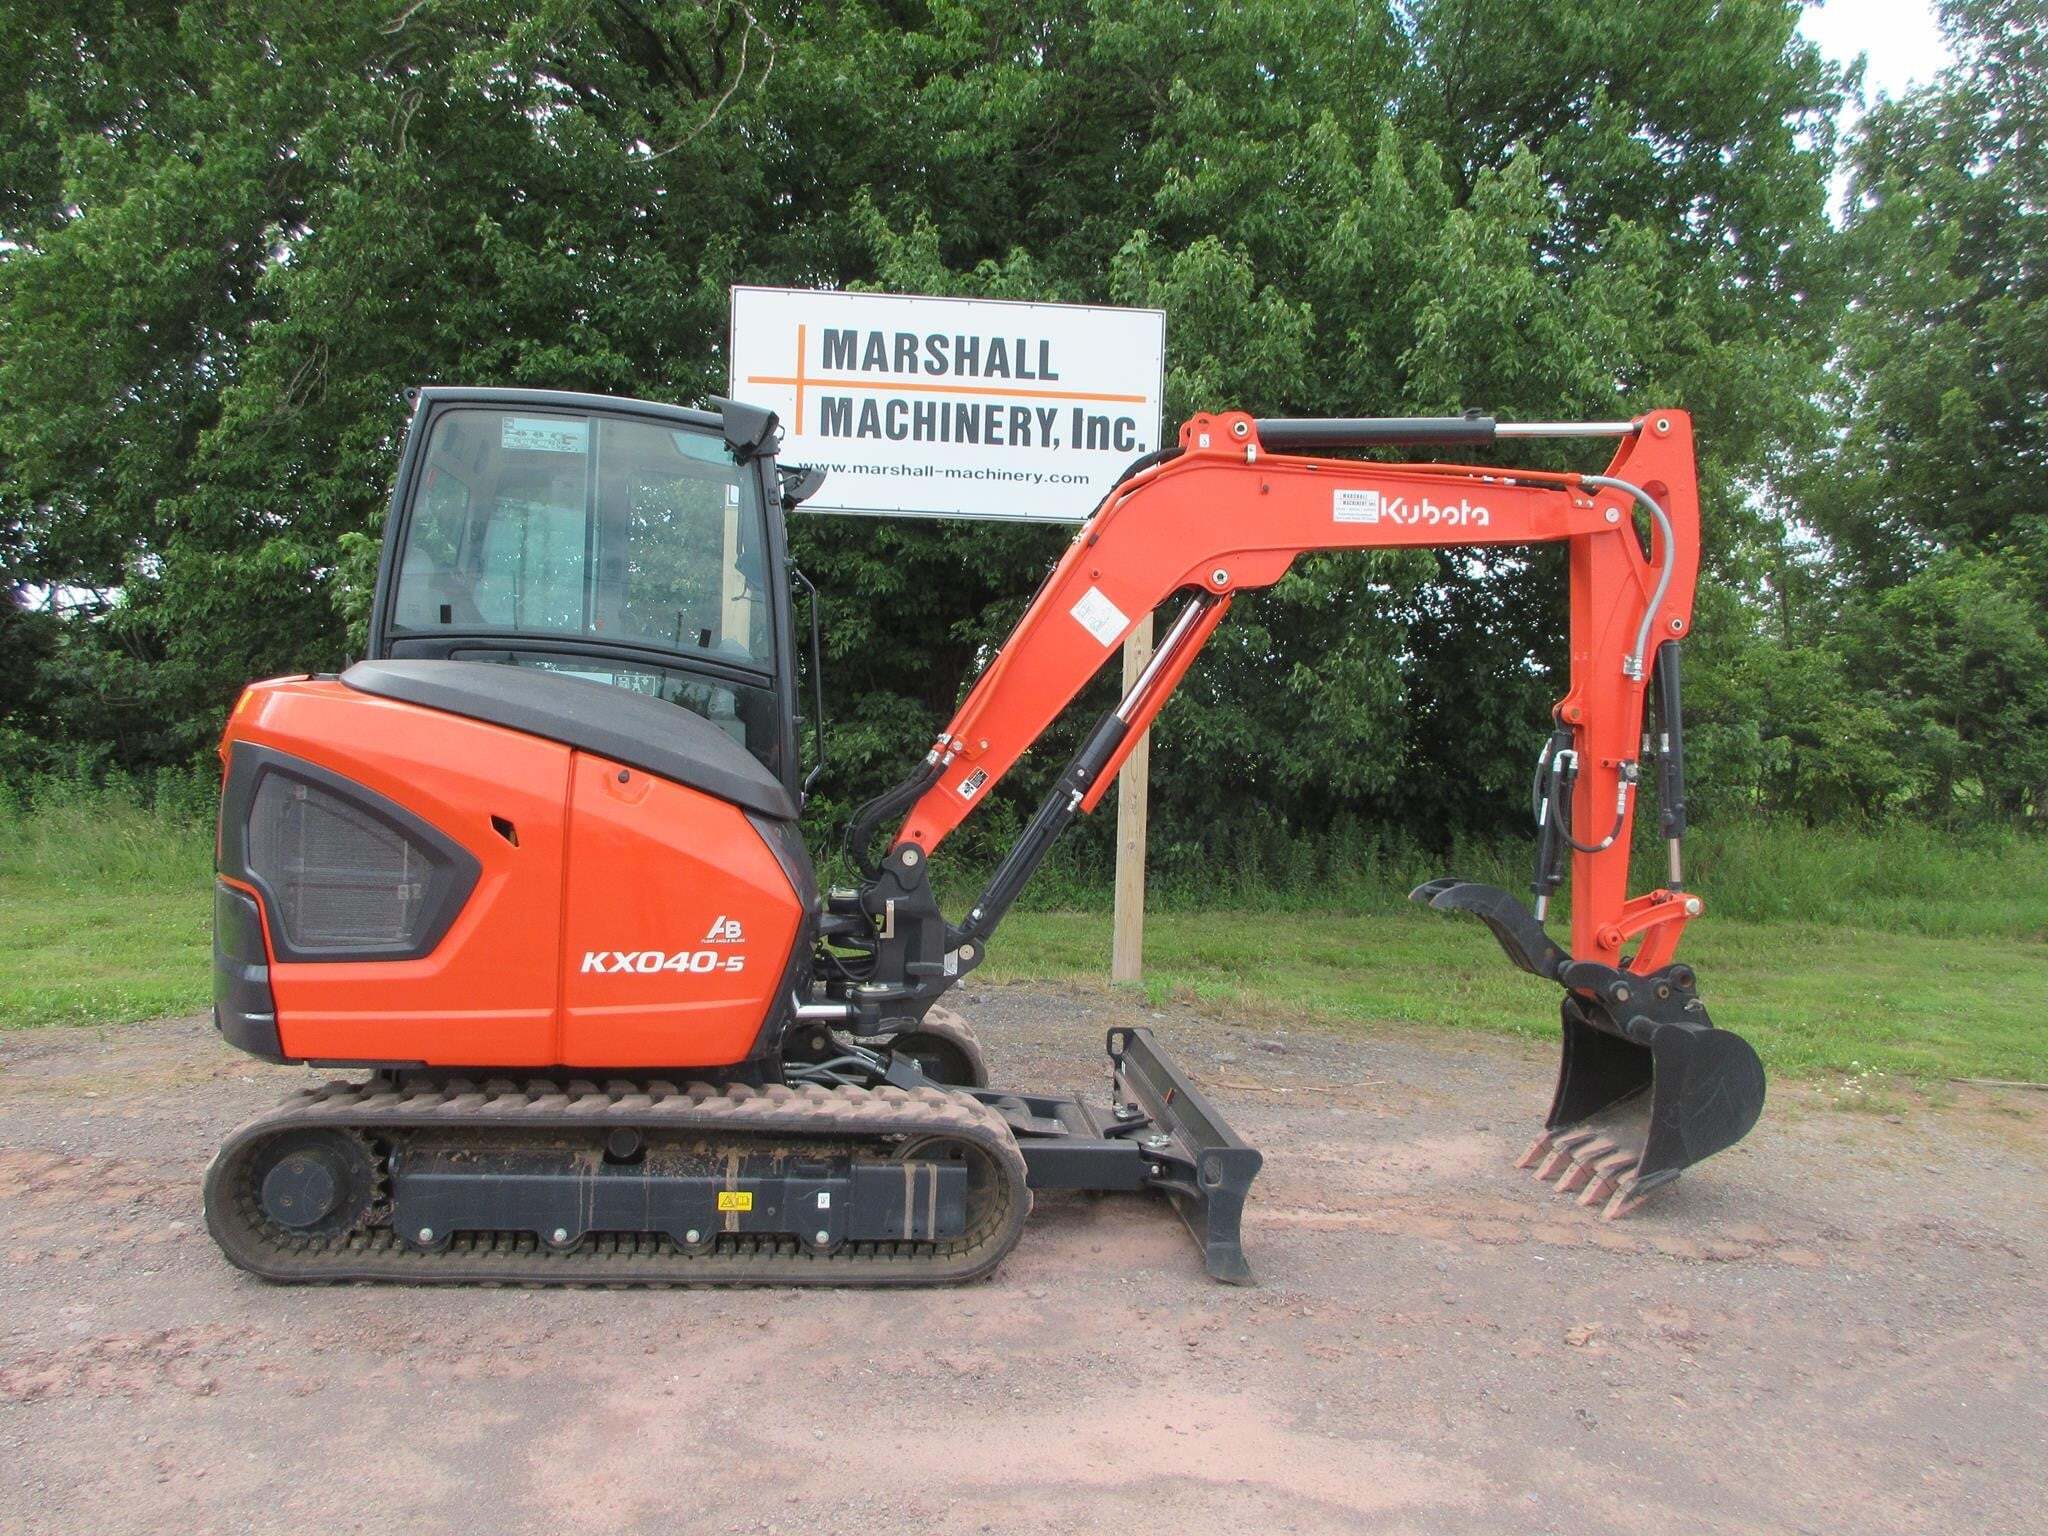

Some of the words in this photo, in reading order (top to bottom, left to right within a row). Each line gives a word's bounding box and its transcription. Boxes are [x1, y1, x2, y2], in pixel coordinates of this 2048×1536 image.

[822, 328, 1059, 381] MARSHALL
[820, 396, 1060, 451] MACHINERY,
[1071, 407, 1146, 453] Inc.
[798, 461, 1090, 485] www.marshall-machinery.com
[1380, 496, 1490, 526] Kubota
[580, 951, 745, 973] KX040-5
